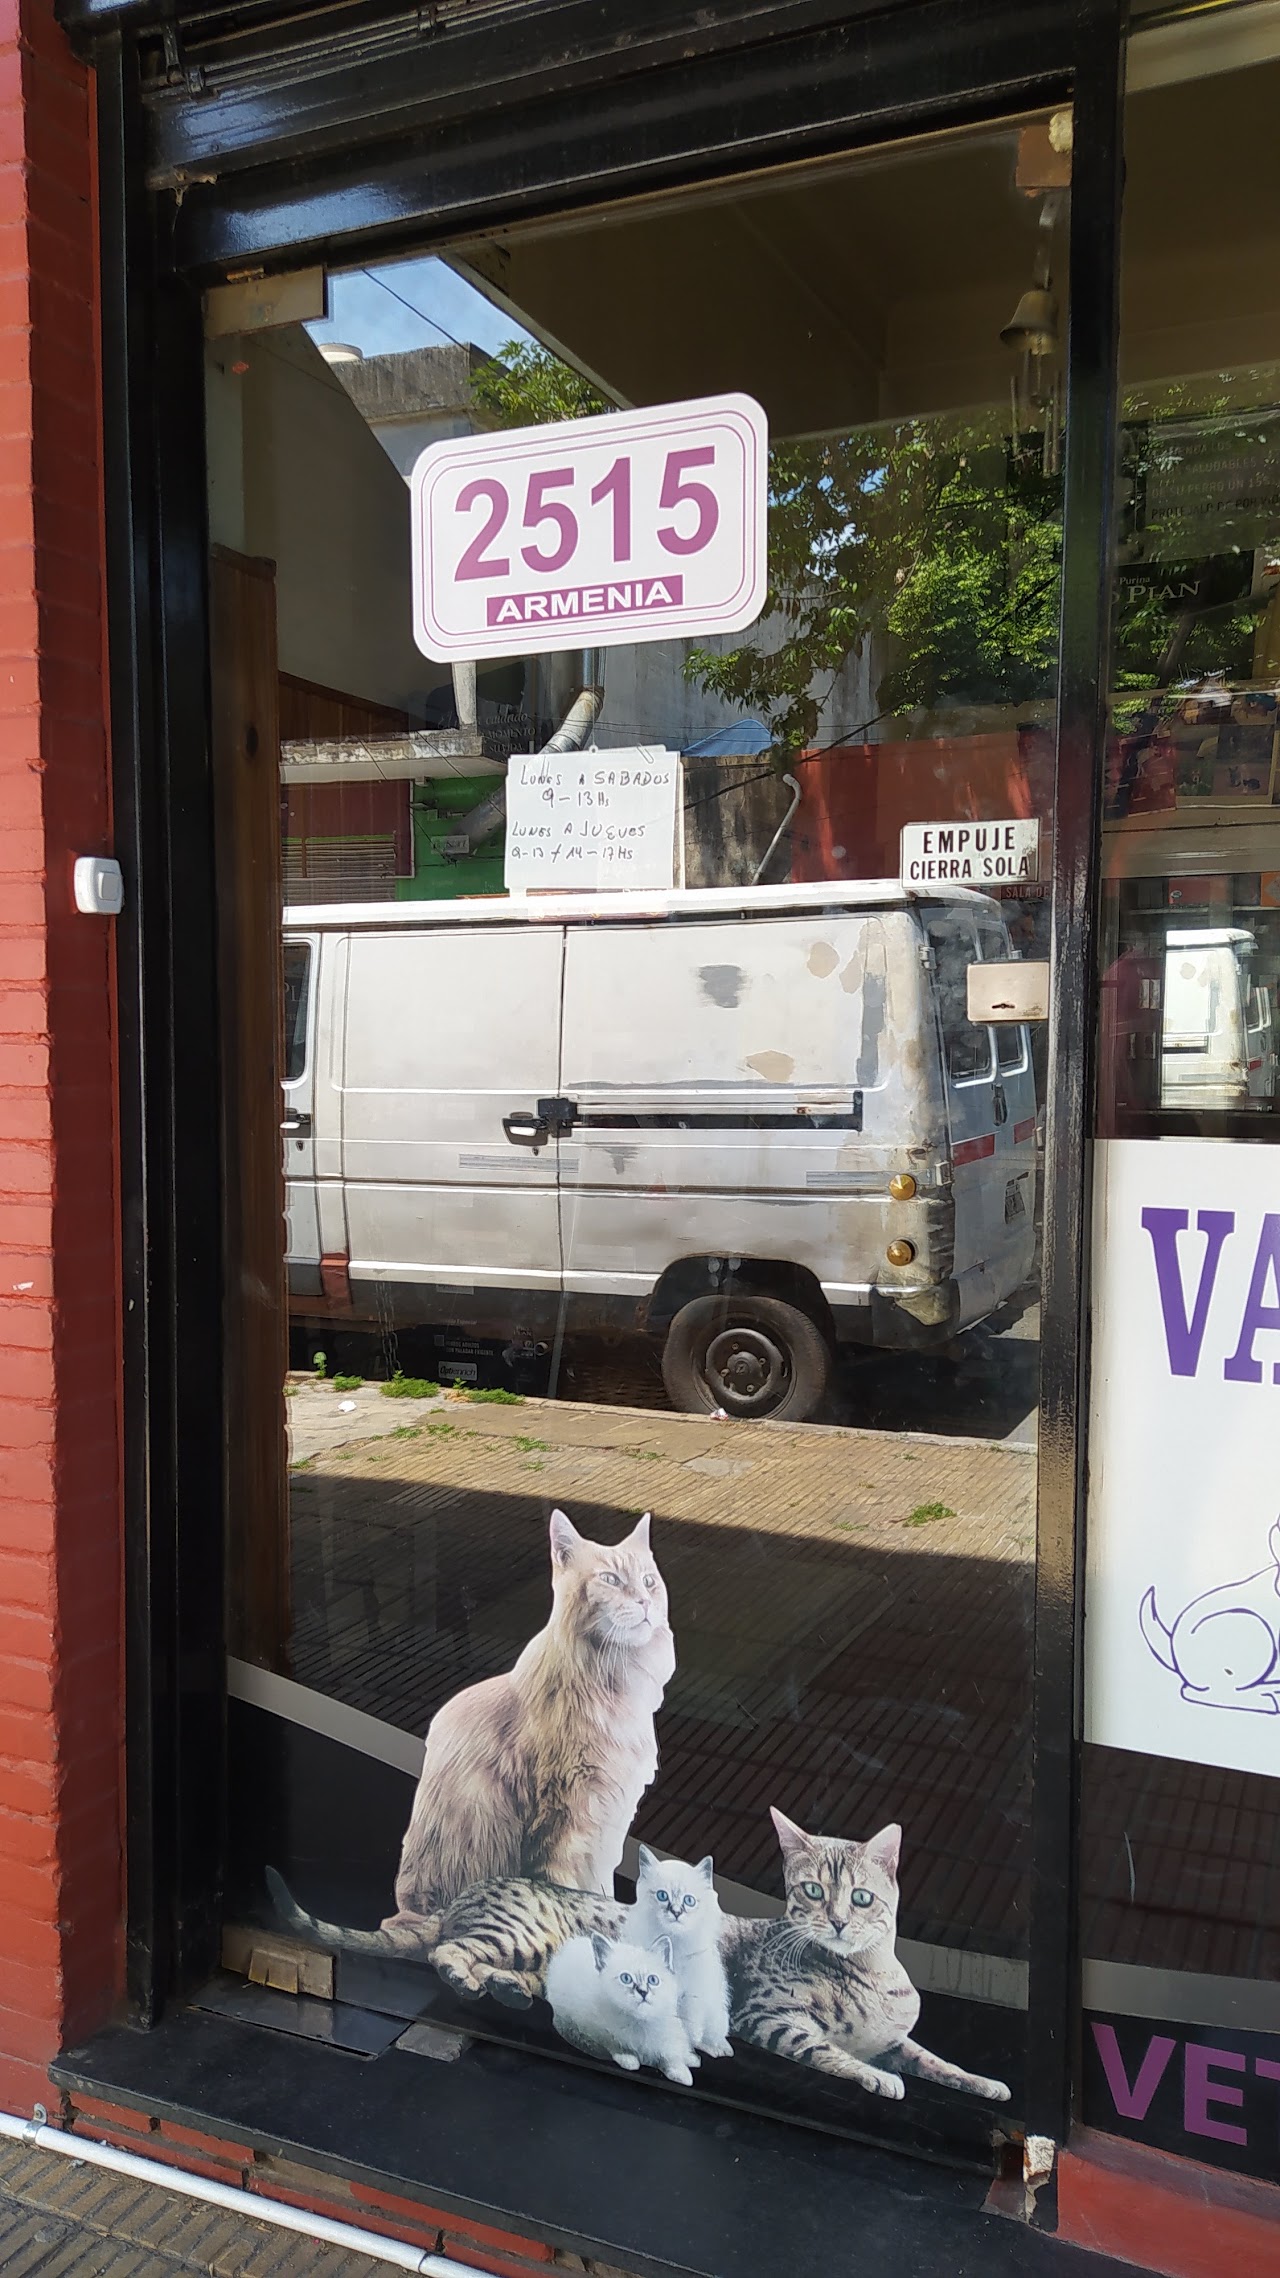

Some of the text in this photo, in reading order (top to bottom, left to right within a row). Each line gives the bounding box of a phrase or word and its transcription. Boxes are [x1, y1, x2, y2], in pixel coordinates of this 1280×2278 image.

[1185, 457, 1257, 474] SALUDABLES
[1188, 481, 1224, 495] PERRO
[1228, 479, 1244, 490] UN
[454, 445, 719, 583] 2515
[1120, 576, 1151, 585] Purina
[496, 580, 673, 623] ARMENIA
[1127, 580, 1201, 604] PLAN
[488, 727, 536, 739] MOMENTO
[521, 765, 669, 786] LUNES A SABADOS
[512, 820, 646, 840] LUNES A JUEVES
[923, 826, 1016, 854] EMPUJE
[910, 856, 1029, 880] CIERRA SOLA
[1006, 886, 1049, 899] SALA DE
